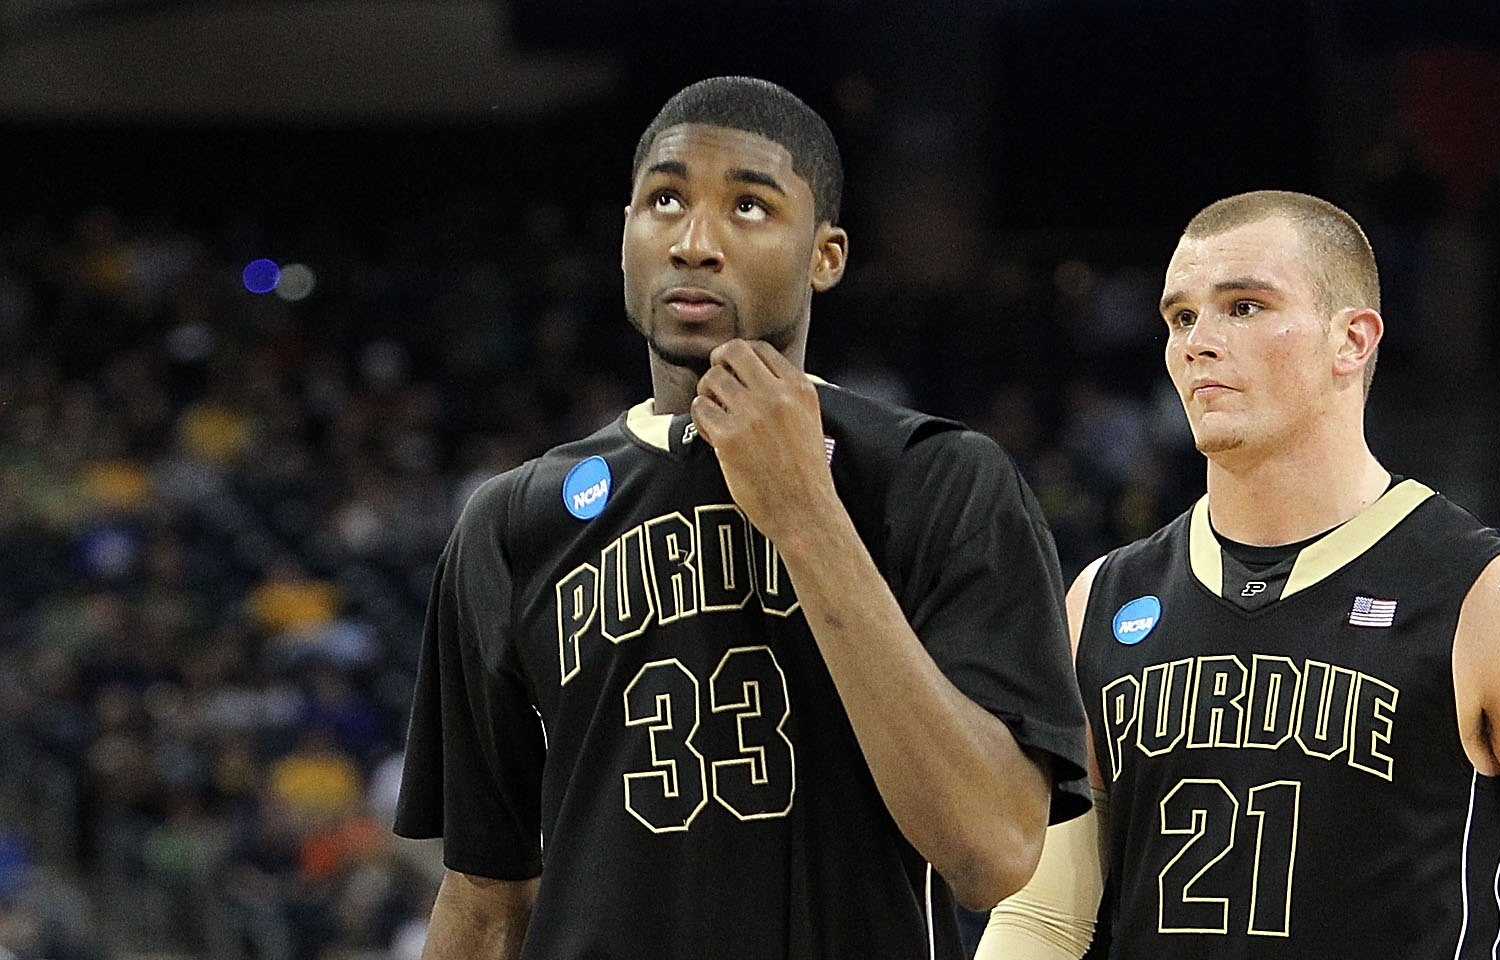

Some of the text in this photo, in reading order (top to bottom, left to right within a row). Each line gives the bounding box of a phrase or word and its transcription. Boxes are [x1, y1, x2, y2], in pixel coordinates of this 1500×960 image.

[572, 478, 608, 511] NCAA
[555, 504, 800, 686] PURDU
[1118, 616, 1154, 634] NCAA
[1240, 581, 1267, 597] P
[623, 645, 796, 833] 33
[1102, 653, 1400, 782] PURDUE
[1158, 778, 1302, 937] 21
